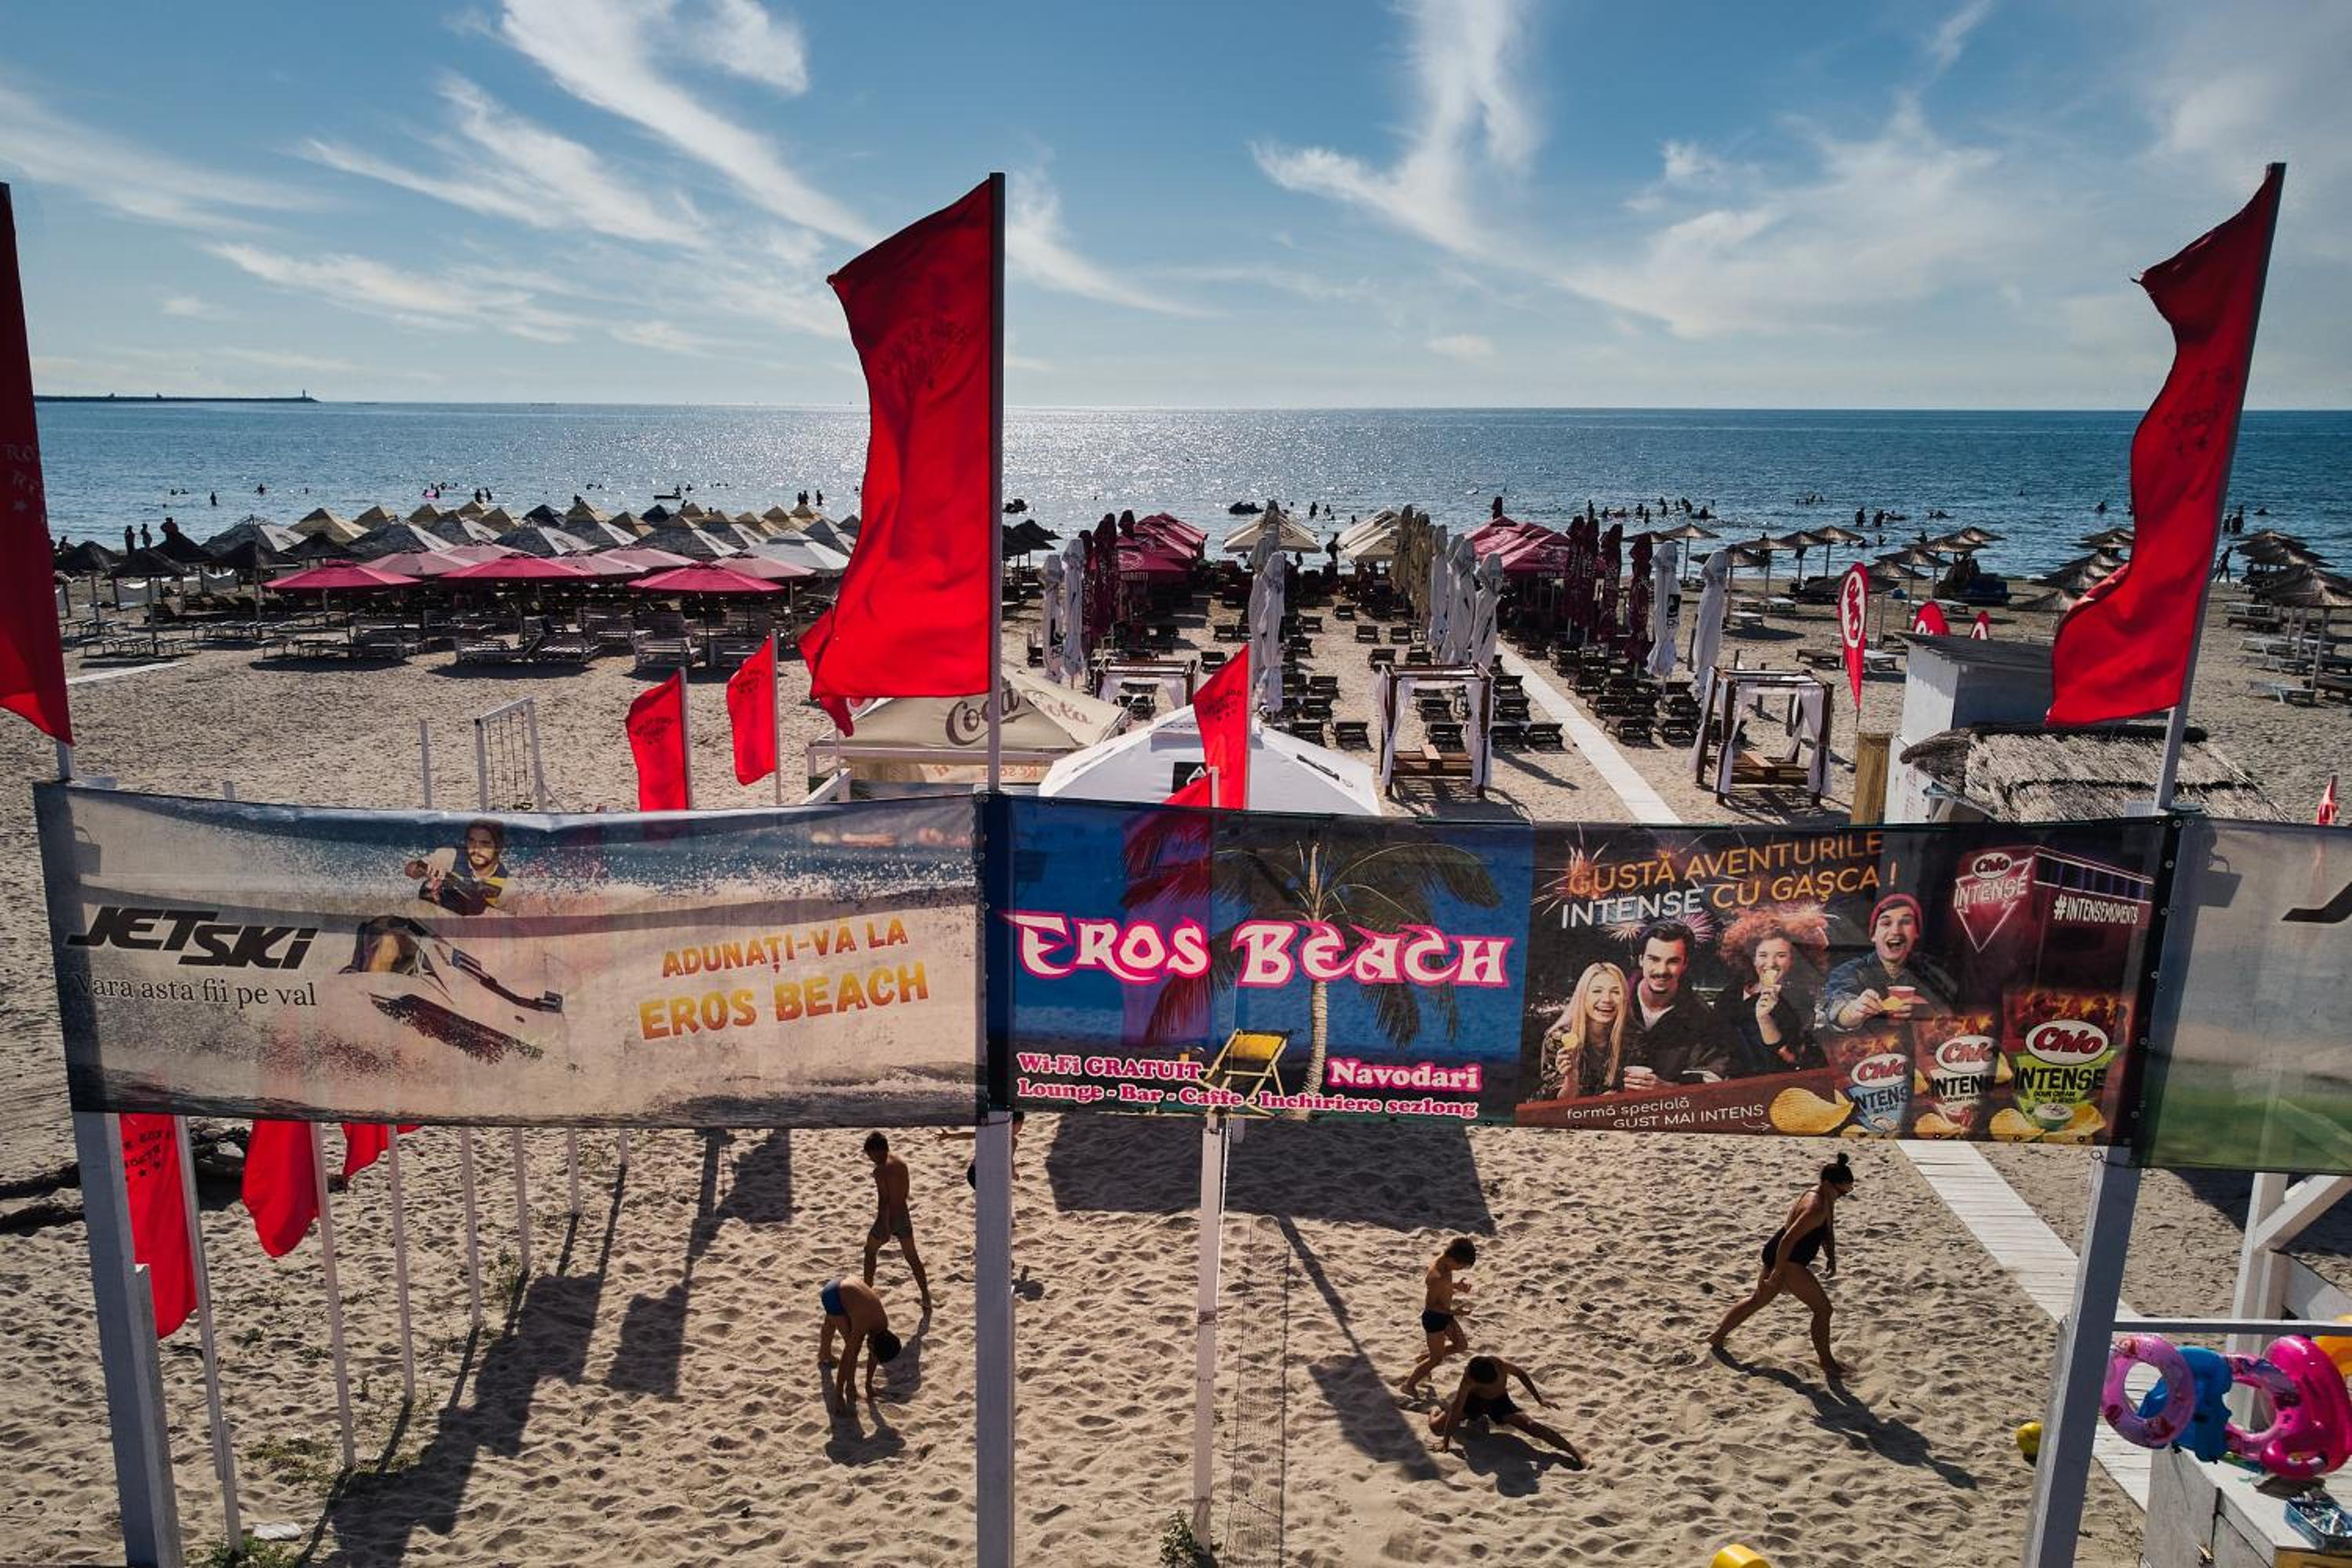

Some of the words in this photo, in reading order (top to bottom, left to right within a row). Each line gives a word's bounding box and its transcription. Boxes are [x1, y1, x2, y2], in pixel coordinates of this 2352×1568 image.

[1568, 851, 1675, 895] GUSTĂ
[1684, 831, 1886, 881] AVENTURILE
[1561, 888, 1704, 929] INTENSE
[1712, 882, 1760, 909] CU
[1954, 875, 2028, 913] INTENSE
[867, 918, 909, 949] LA
[1004, 911, 1210, 983] EROS
[1232, 920, 1514, 987] BEACH
[141, 979, 195, 1001] asta
[202, 978, 230, 1003] fii
[238, 986, 268, 1008] pe
[276, 982, 318, 1006] val
[639, 989, 758, 1041] EROS
[774, 961, 929, 1022] BEACH
[1017, 1053, 1082, 1075] Wi-Fi
[1085, 1057, 1203, 1080] GRATUIT
[1328, 1059, 1480, 1091] Navodari
[2013, 1066, 2107, 1091] INTENSE
[1018, 1077, 1103, 1104] Lounge
[1119, 1083, 1164, 1104] Bar
[1178, 1086, 1243, 1107] Caffe
[1259, 1090, 1381, 1112] Inchiriere
[1385, 1096, 1478, 1119] sezlong
[1613, 1114, 1660, 1128] GUST
[1664, 1112, 1695, 1126] MAI
[1700, 1103, 1764, 1123] INTENS
